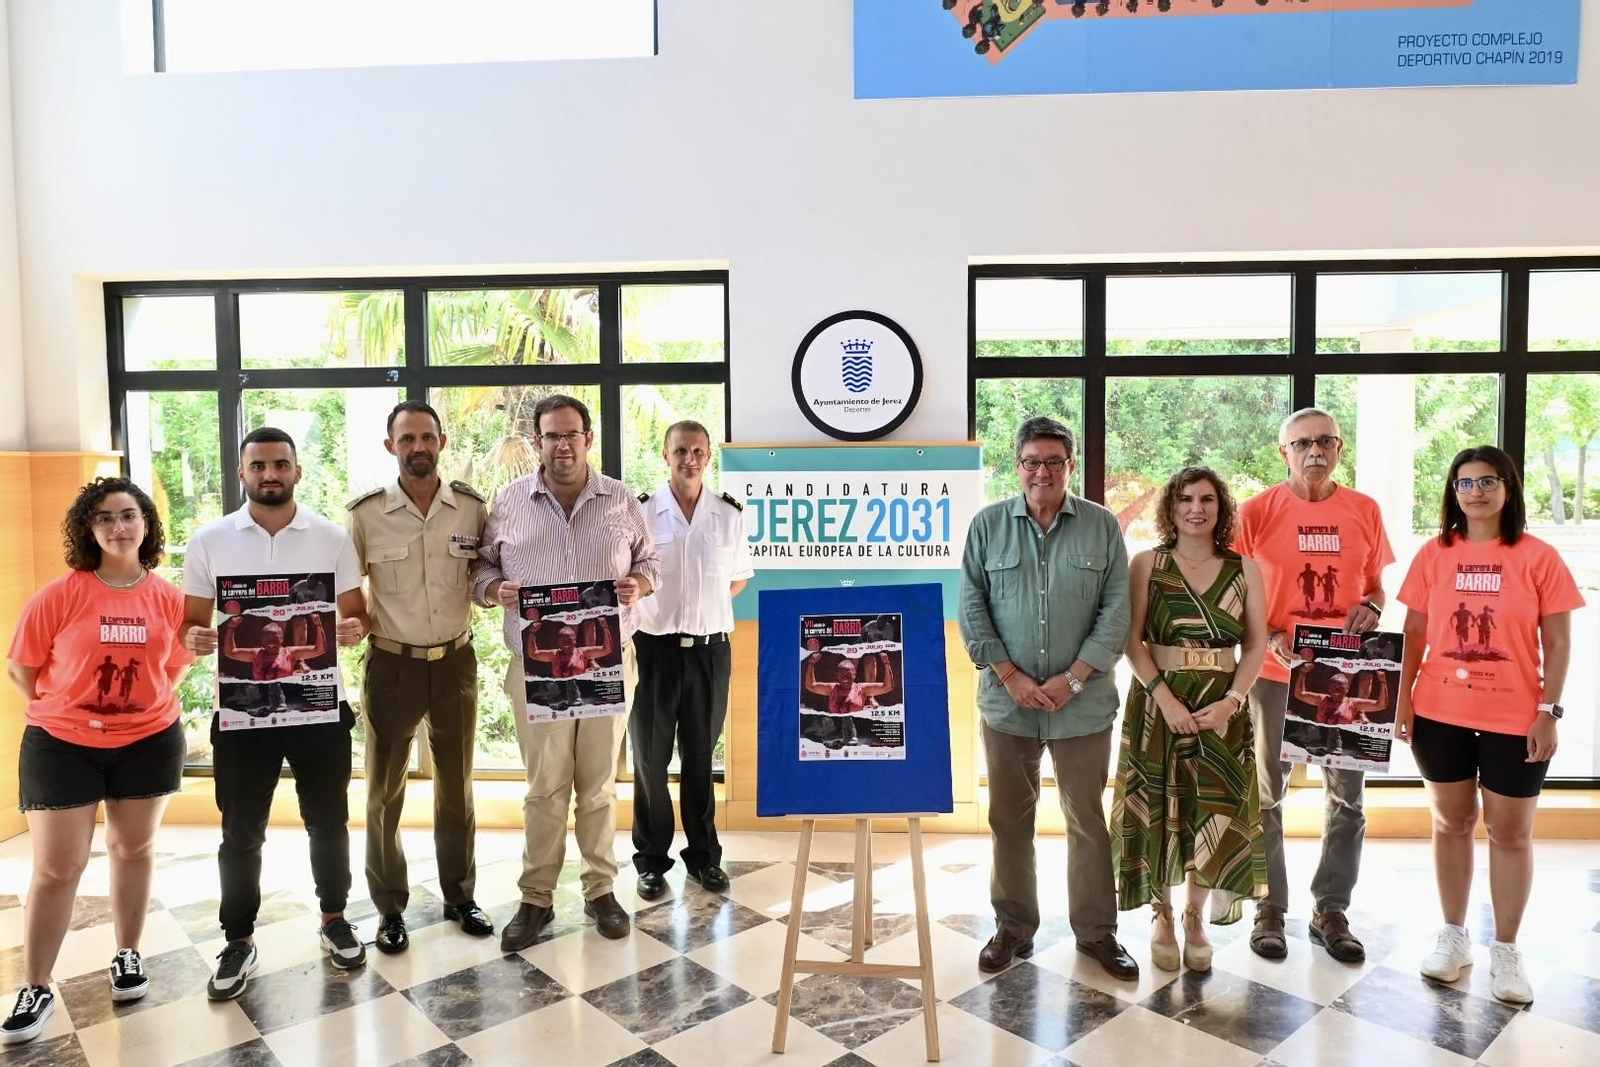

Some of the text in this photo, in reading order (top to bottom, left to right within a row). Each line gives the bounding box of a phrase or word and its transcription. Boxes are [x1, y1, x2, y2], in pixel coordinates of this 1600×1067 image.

[1398, 32, 1543, 48] PROYECTO COMPLEJO
[1398, 49, 1563, 67] DEPORTIVO CHAPÍN 2019
[813, 398, 869, 408] Ayuntamiento
[882, 397, 902, 406] Jerez
[746, 482, 949, 497] CANDIDATURA
[746, 498, 950, 544] JEREZ 2031
[1298, 534, 1340, 551] BARRO
[799, 545, 853, 557] EUROPEA
[858, 545, 873, 557] DE
[878, 545, 892, 557] LA
[898, 544, 950, 557] CULTURA
[1457, 563, 1463, 571] la
[1492, 564, 1502, 572] del
[256, 582, 290, 595] BARRO
[1455, 573, 1502, 592] BARRO
[552, 590, 580, 604] BARRO
[100, 624, 146, 644] BARRO
[833, 621, 862, 634] BARRO
[1330, 634, 1361, 649] BARRO
